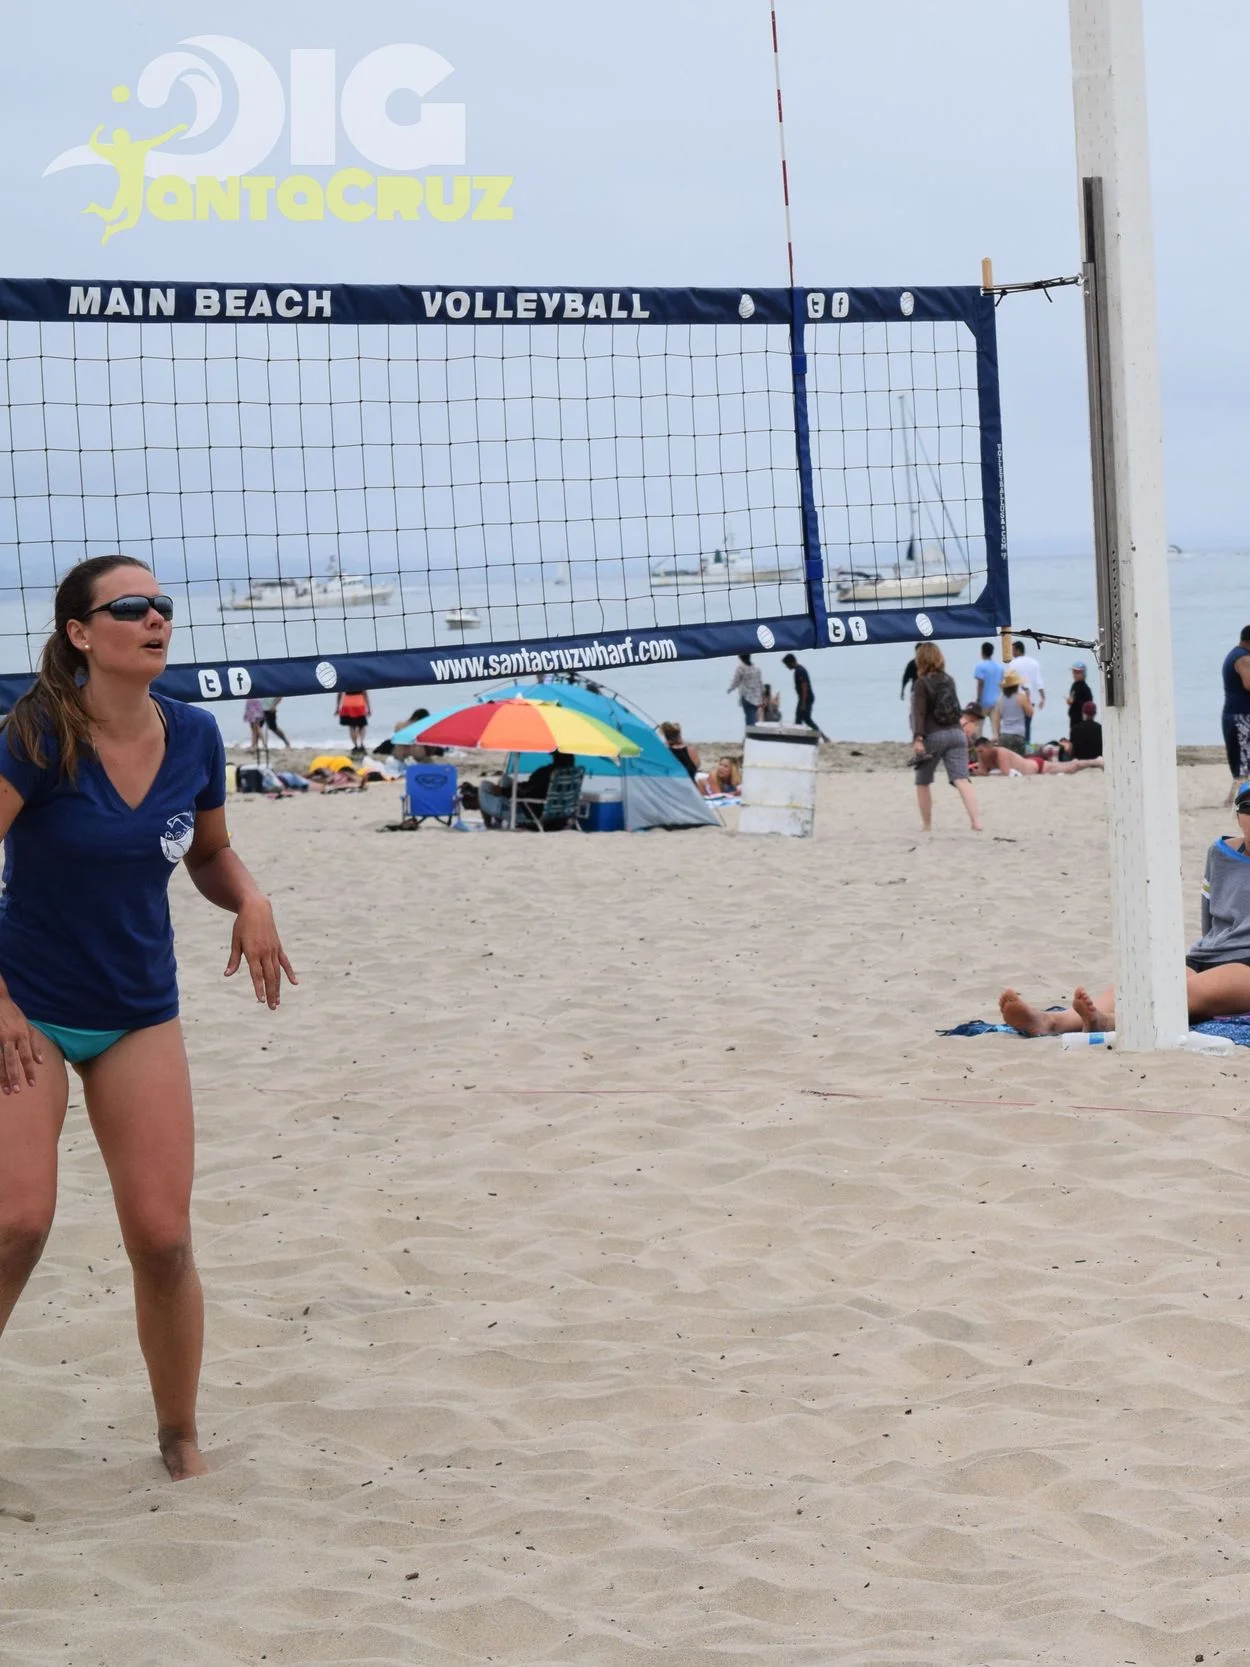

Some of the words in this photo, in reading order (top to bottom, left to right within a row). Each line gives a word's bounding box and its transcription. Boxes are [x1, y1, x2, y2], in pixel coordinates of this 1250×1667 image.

[68, 286, 176, 316] MAIN
[194, 288, 332, 318] BEACH
[421, 290, 650, 319] VOLLEYBALL
[430, 636, 678, 681] www.santacruzwharf.com
